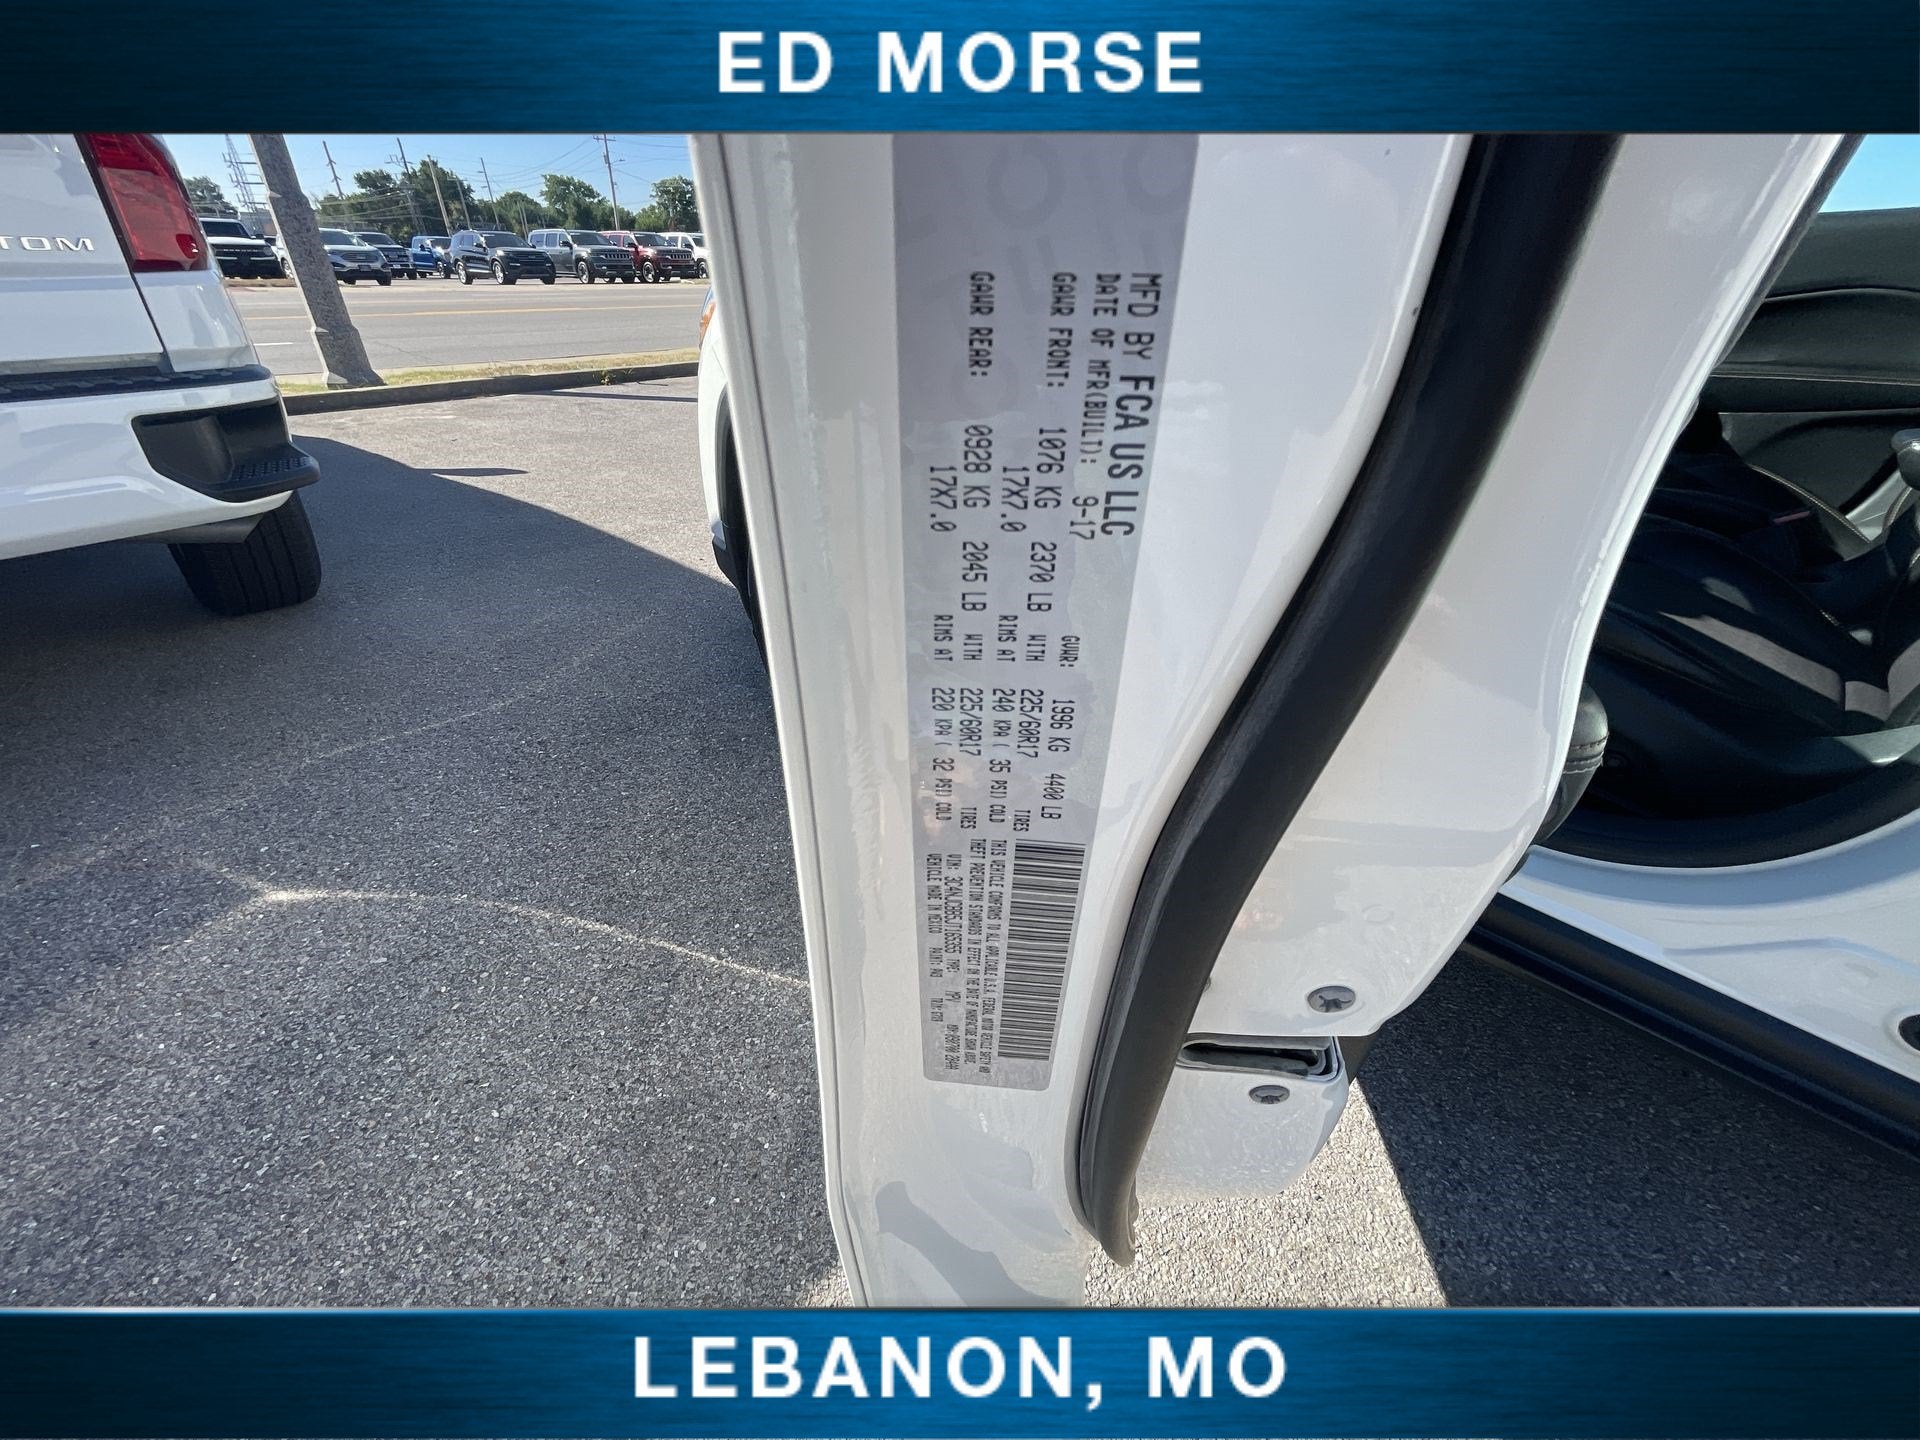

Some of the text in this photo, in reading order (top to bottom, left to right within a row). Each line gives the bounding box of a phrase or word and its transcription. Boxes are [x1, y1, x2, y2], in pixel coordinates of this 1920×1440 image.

[1069, 273, 1120, 540] DATE OF MFR(BUILT): 9-17
[1101, 273, 1162, 535] MFD BY FCA US LLC
[929, 465, 956, 532] 17X7.0
[1000, 466, 1029, 532] 17X7.0
[960, 271, 994, 829] GAWR REAR: 0928 KG 2045 LB WITH 225/60R17 TIRES
[1013, 273, 1076, 832] GAWR FRONT: 1076 KG 2370 LB WITH 225/60R17 TIRES
[934, 615, 952, 645] RIMS
[998, 615, 1017, 644] RIMS
[934, 649, 952, 661] AT
[997, 649, 1015, 661] AT
[932, 688, 954, 712] 220
[992, 688, 1015, 712] 240
[934, 719, 953, 736] KPA
[993, 720, 1014, 737] KPA
[1041, 636, 1079, 819] GVWR: 1996 KG 4400 LB
[933, 757, 954, 771] 32
[990, 759, 1010, 773] 35
[935, 778, 951, 796] PSI)
[990, 780, 1007, 799] PSI)
[936, 802, 951, 820] COLD
[990, 804, 1005, 822] COLD
[971, 839, 986, 859] THEFT
[991, 840, 1007, 856] THIS
[927, 853, 943, 881] VEHICLE
[946, 854, 961, 869] VIN:
[970, 862, 985, 901] PREVENTION
[989, 860, 1005, 887] VEHICLE
[928, 885, 942, 900] MADE
[944, 876, 963, 954] 3C4NJCBB5JT165355
[987, 891, 1004, 920] CONFORMS
[928, 914, 943, 934] MEXICO
[968, 904, 984, 935] STANDARDS
[986, 933, 1000, 942] ALL
[929, 947, 944, 965] PAINT:
[968, 947, 981, 966] EFFECT
[984, 946, 999, 976] APPLICABLE
[947, 959, 960, 973] TYPE:
[967, 978, 980, 986] THE
[945, 991, 961, 1003] MPV
[966, 988, 980, 999] DATE
[982, 998, 995, 1015] FEDERAL
[980, 1033, 992, 1049] VEHICLE
